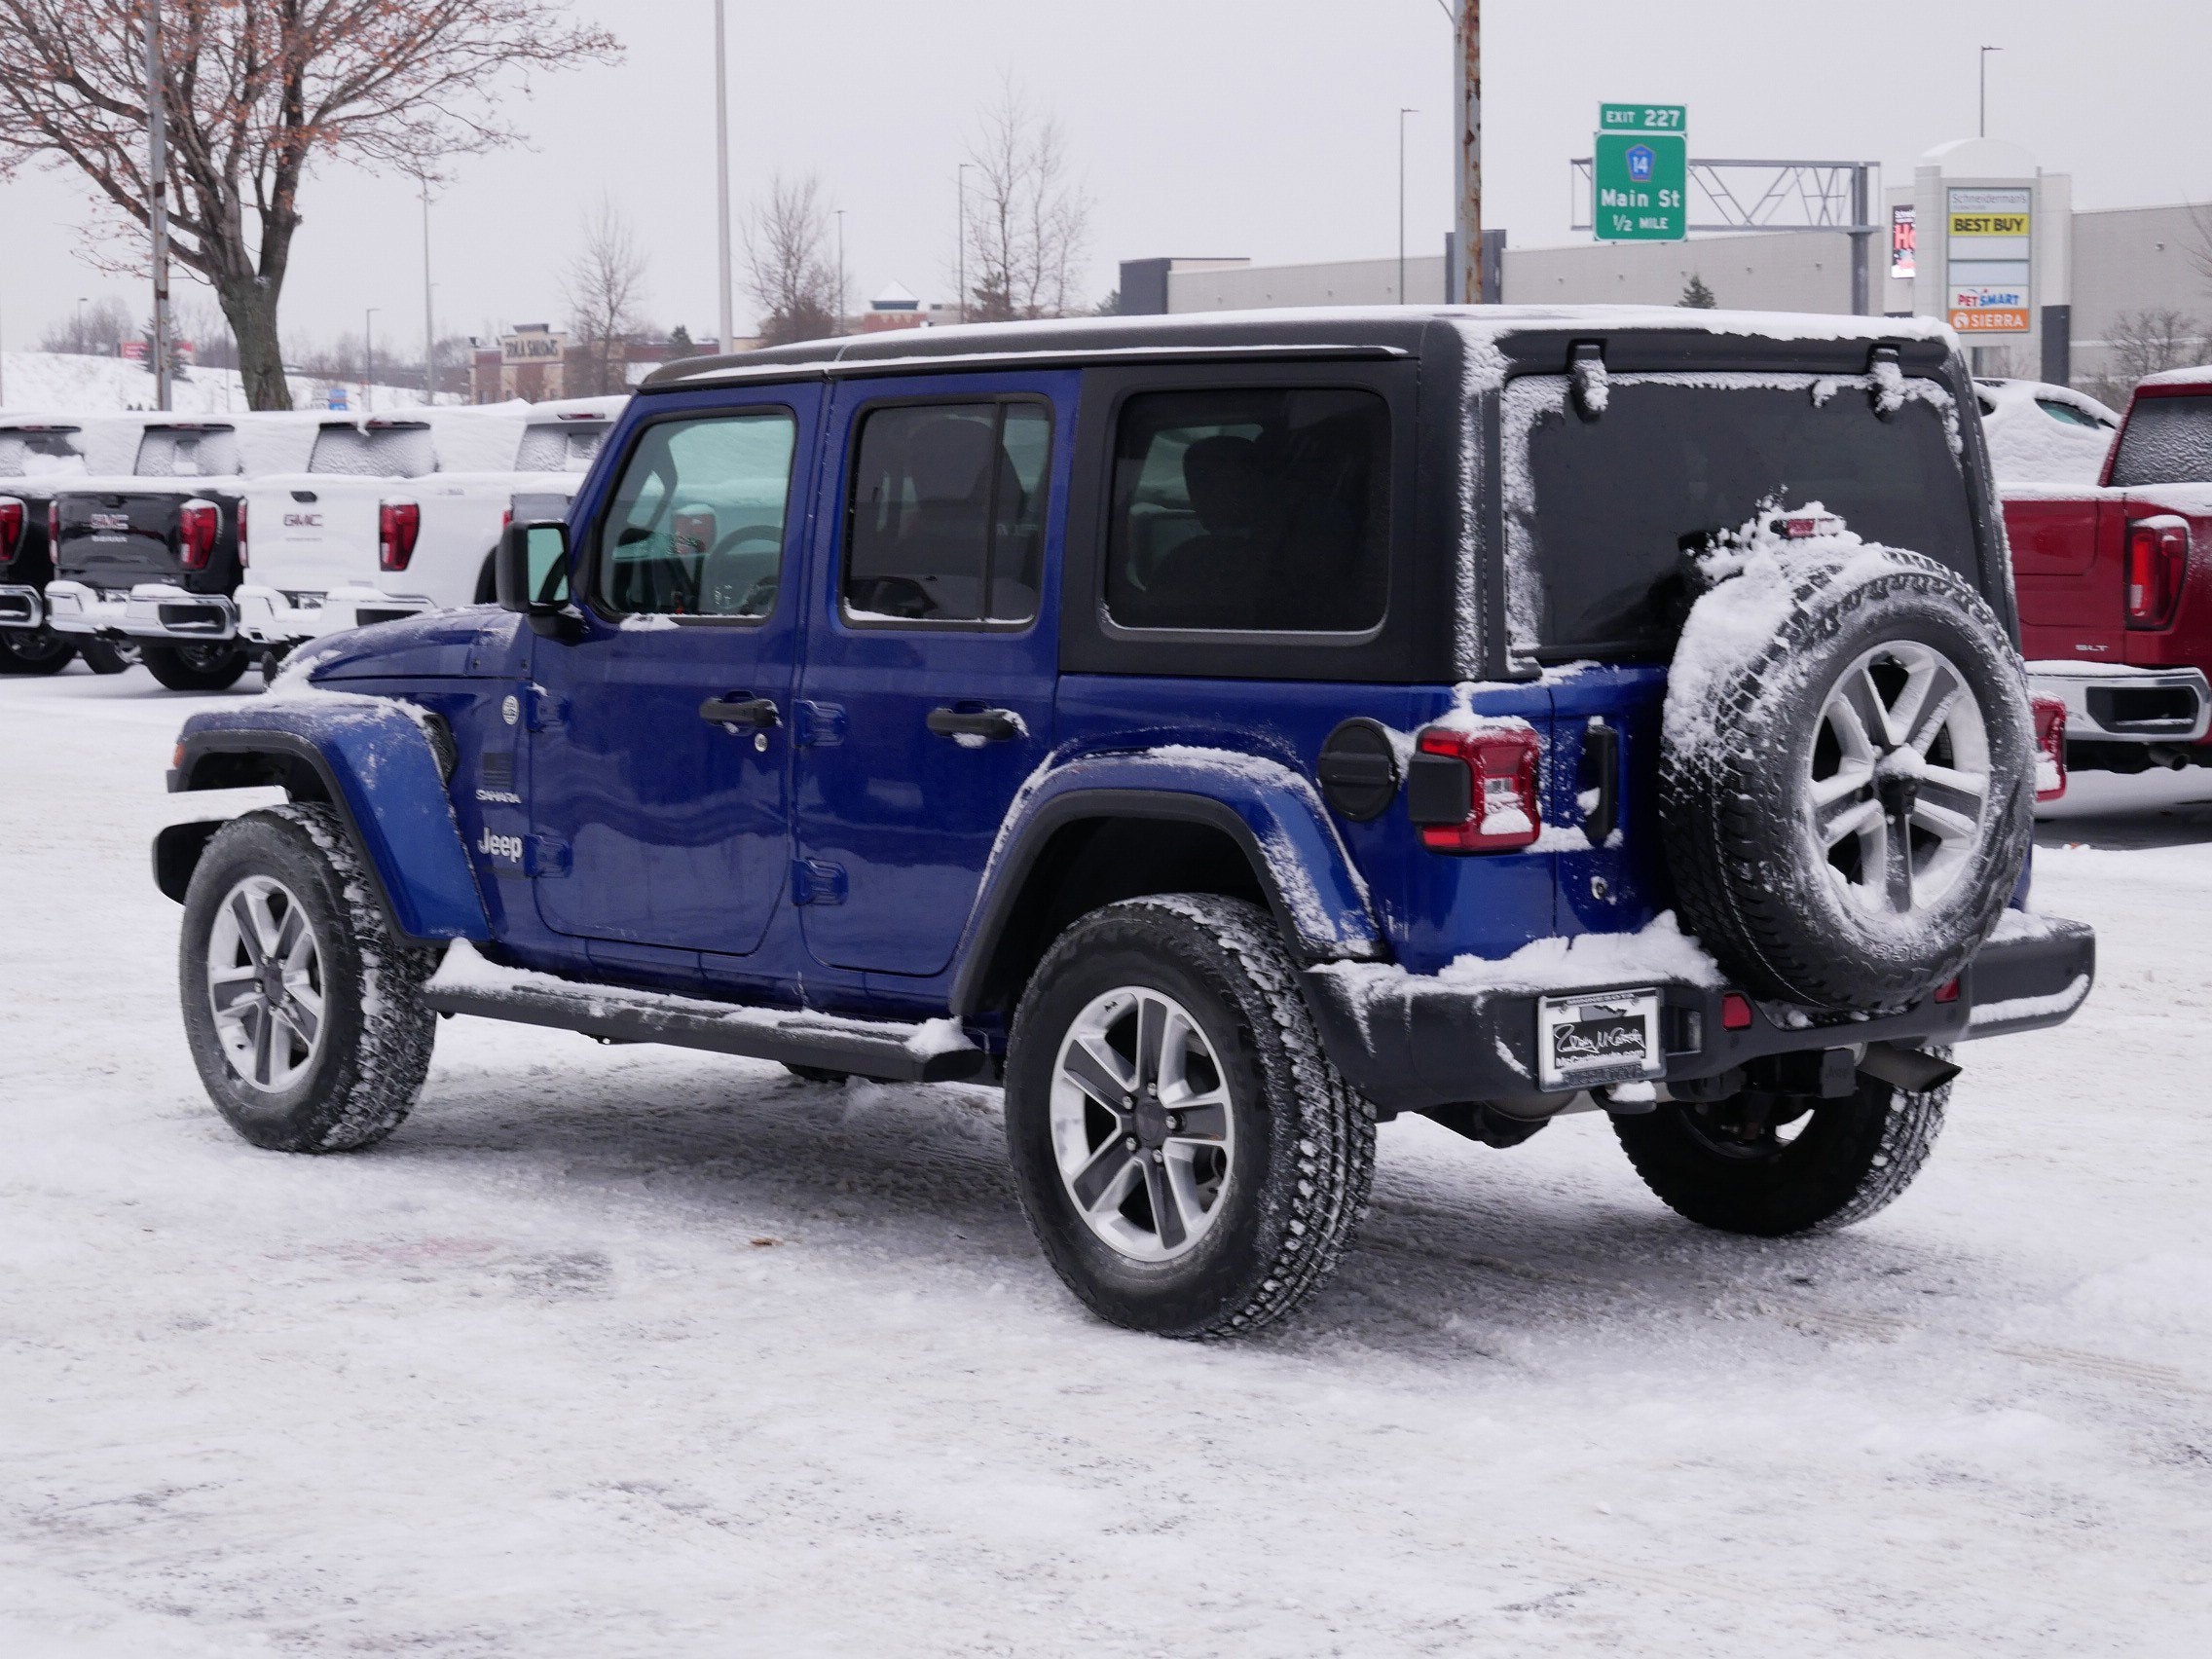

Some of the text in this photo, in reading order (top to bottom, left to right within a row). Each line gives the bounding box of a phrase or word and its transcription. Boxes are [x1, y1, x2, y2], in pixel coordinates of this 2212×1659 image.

[1605, 108, 1680, 127] EXIT 227
[1633, 156, 1648, 173] 14
[1601, 188, 1680, 207] Main St
[1639, 216, 1669, 230] MILE
[1954, 217, 2024, 232] BEST BUY
[1971, 313, 2024, 328] SIERRA
[283, 514, 323, 527] GMC
[477, 827, 524, 864] Jeep
